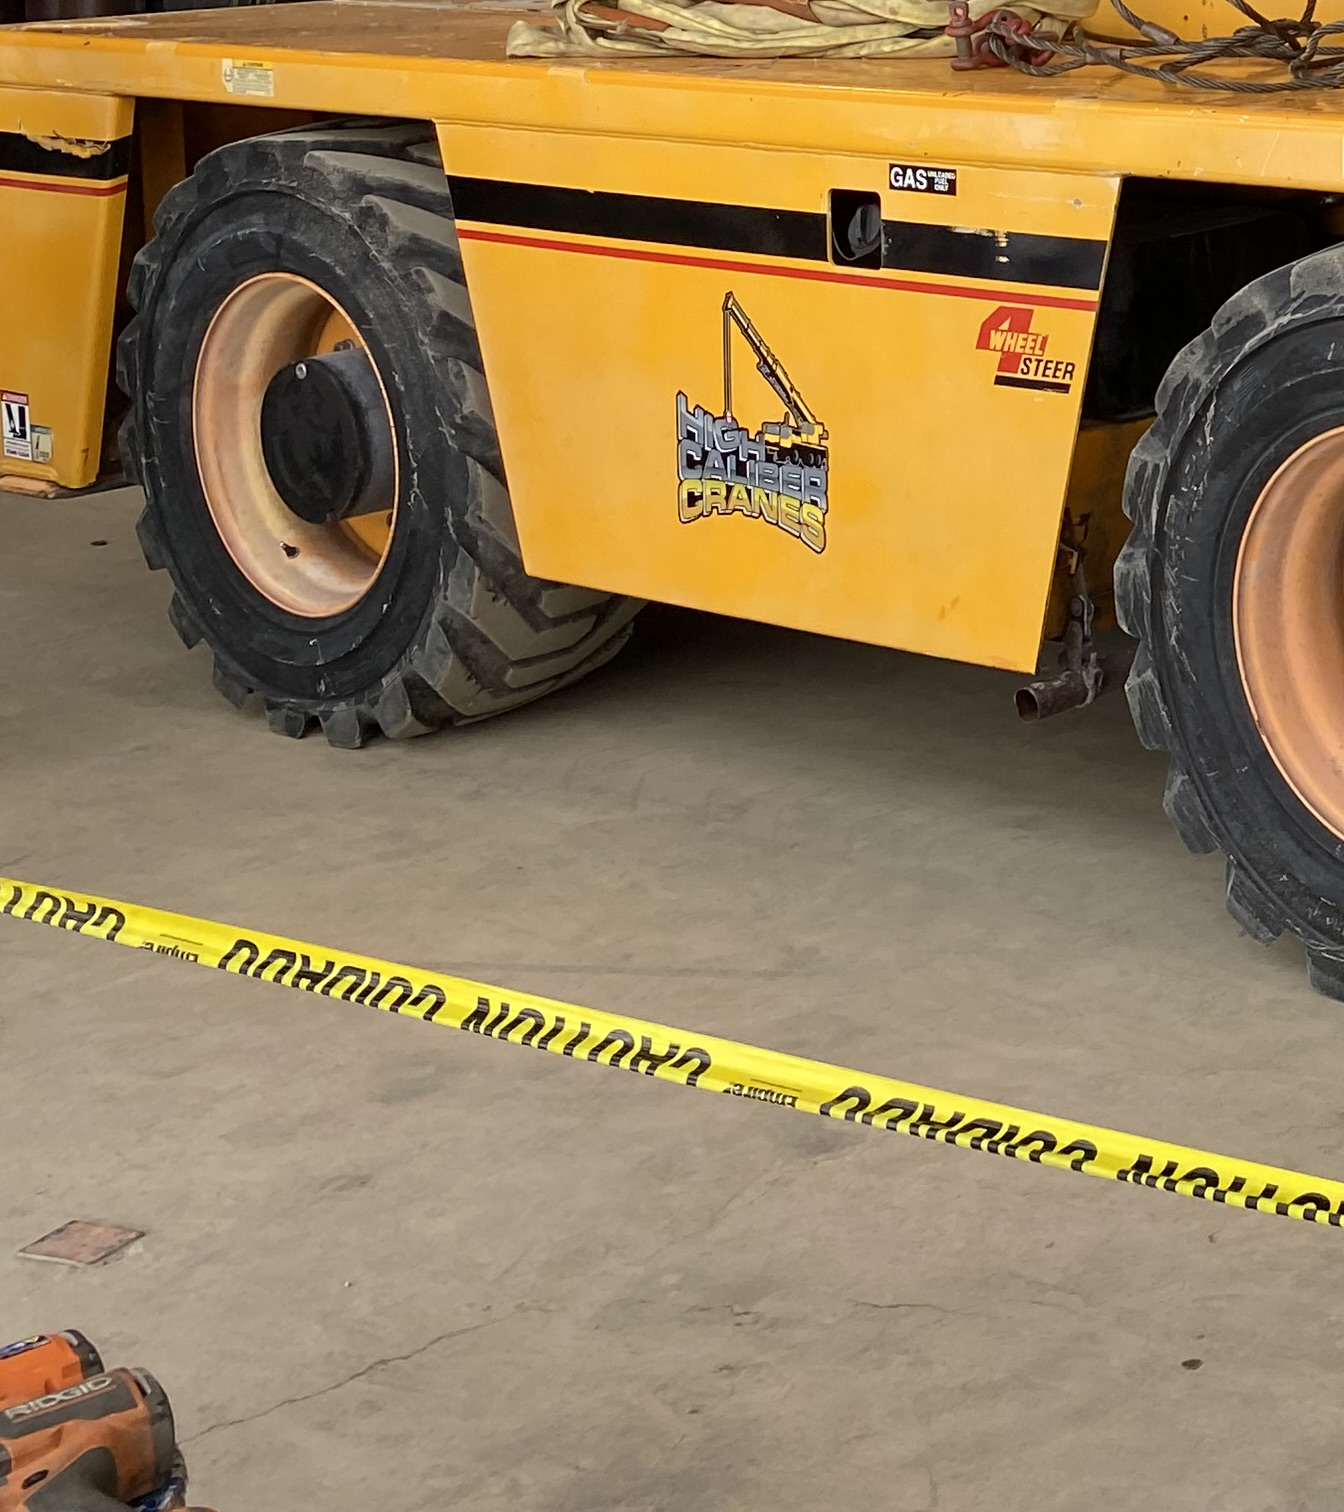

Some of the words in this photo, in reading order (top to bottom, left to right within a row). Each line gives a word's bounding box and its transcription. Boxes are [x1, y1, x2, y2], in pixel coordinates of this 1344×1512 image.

[890, 166, 928, 190] GAS
[975, 305, 1035, 374] 4
[989, 329, 1045, 356] WHEEL
[1020, 357, 1076, 381] STEER
[676, 390, 767, 463] HIGH
[677, 439, 828, 514] CALIBER
[678, 479, 827, 555] CRANES
[2, 886, 126, 942] CAUT
[5, 1377, 113, 1420] RIDGID
